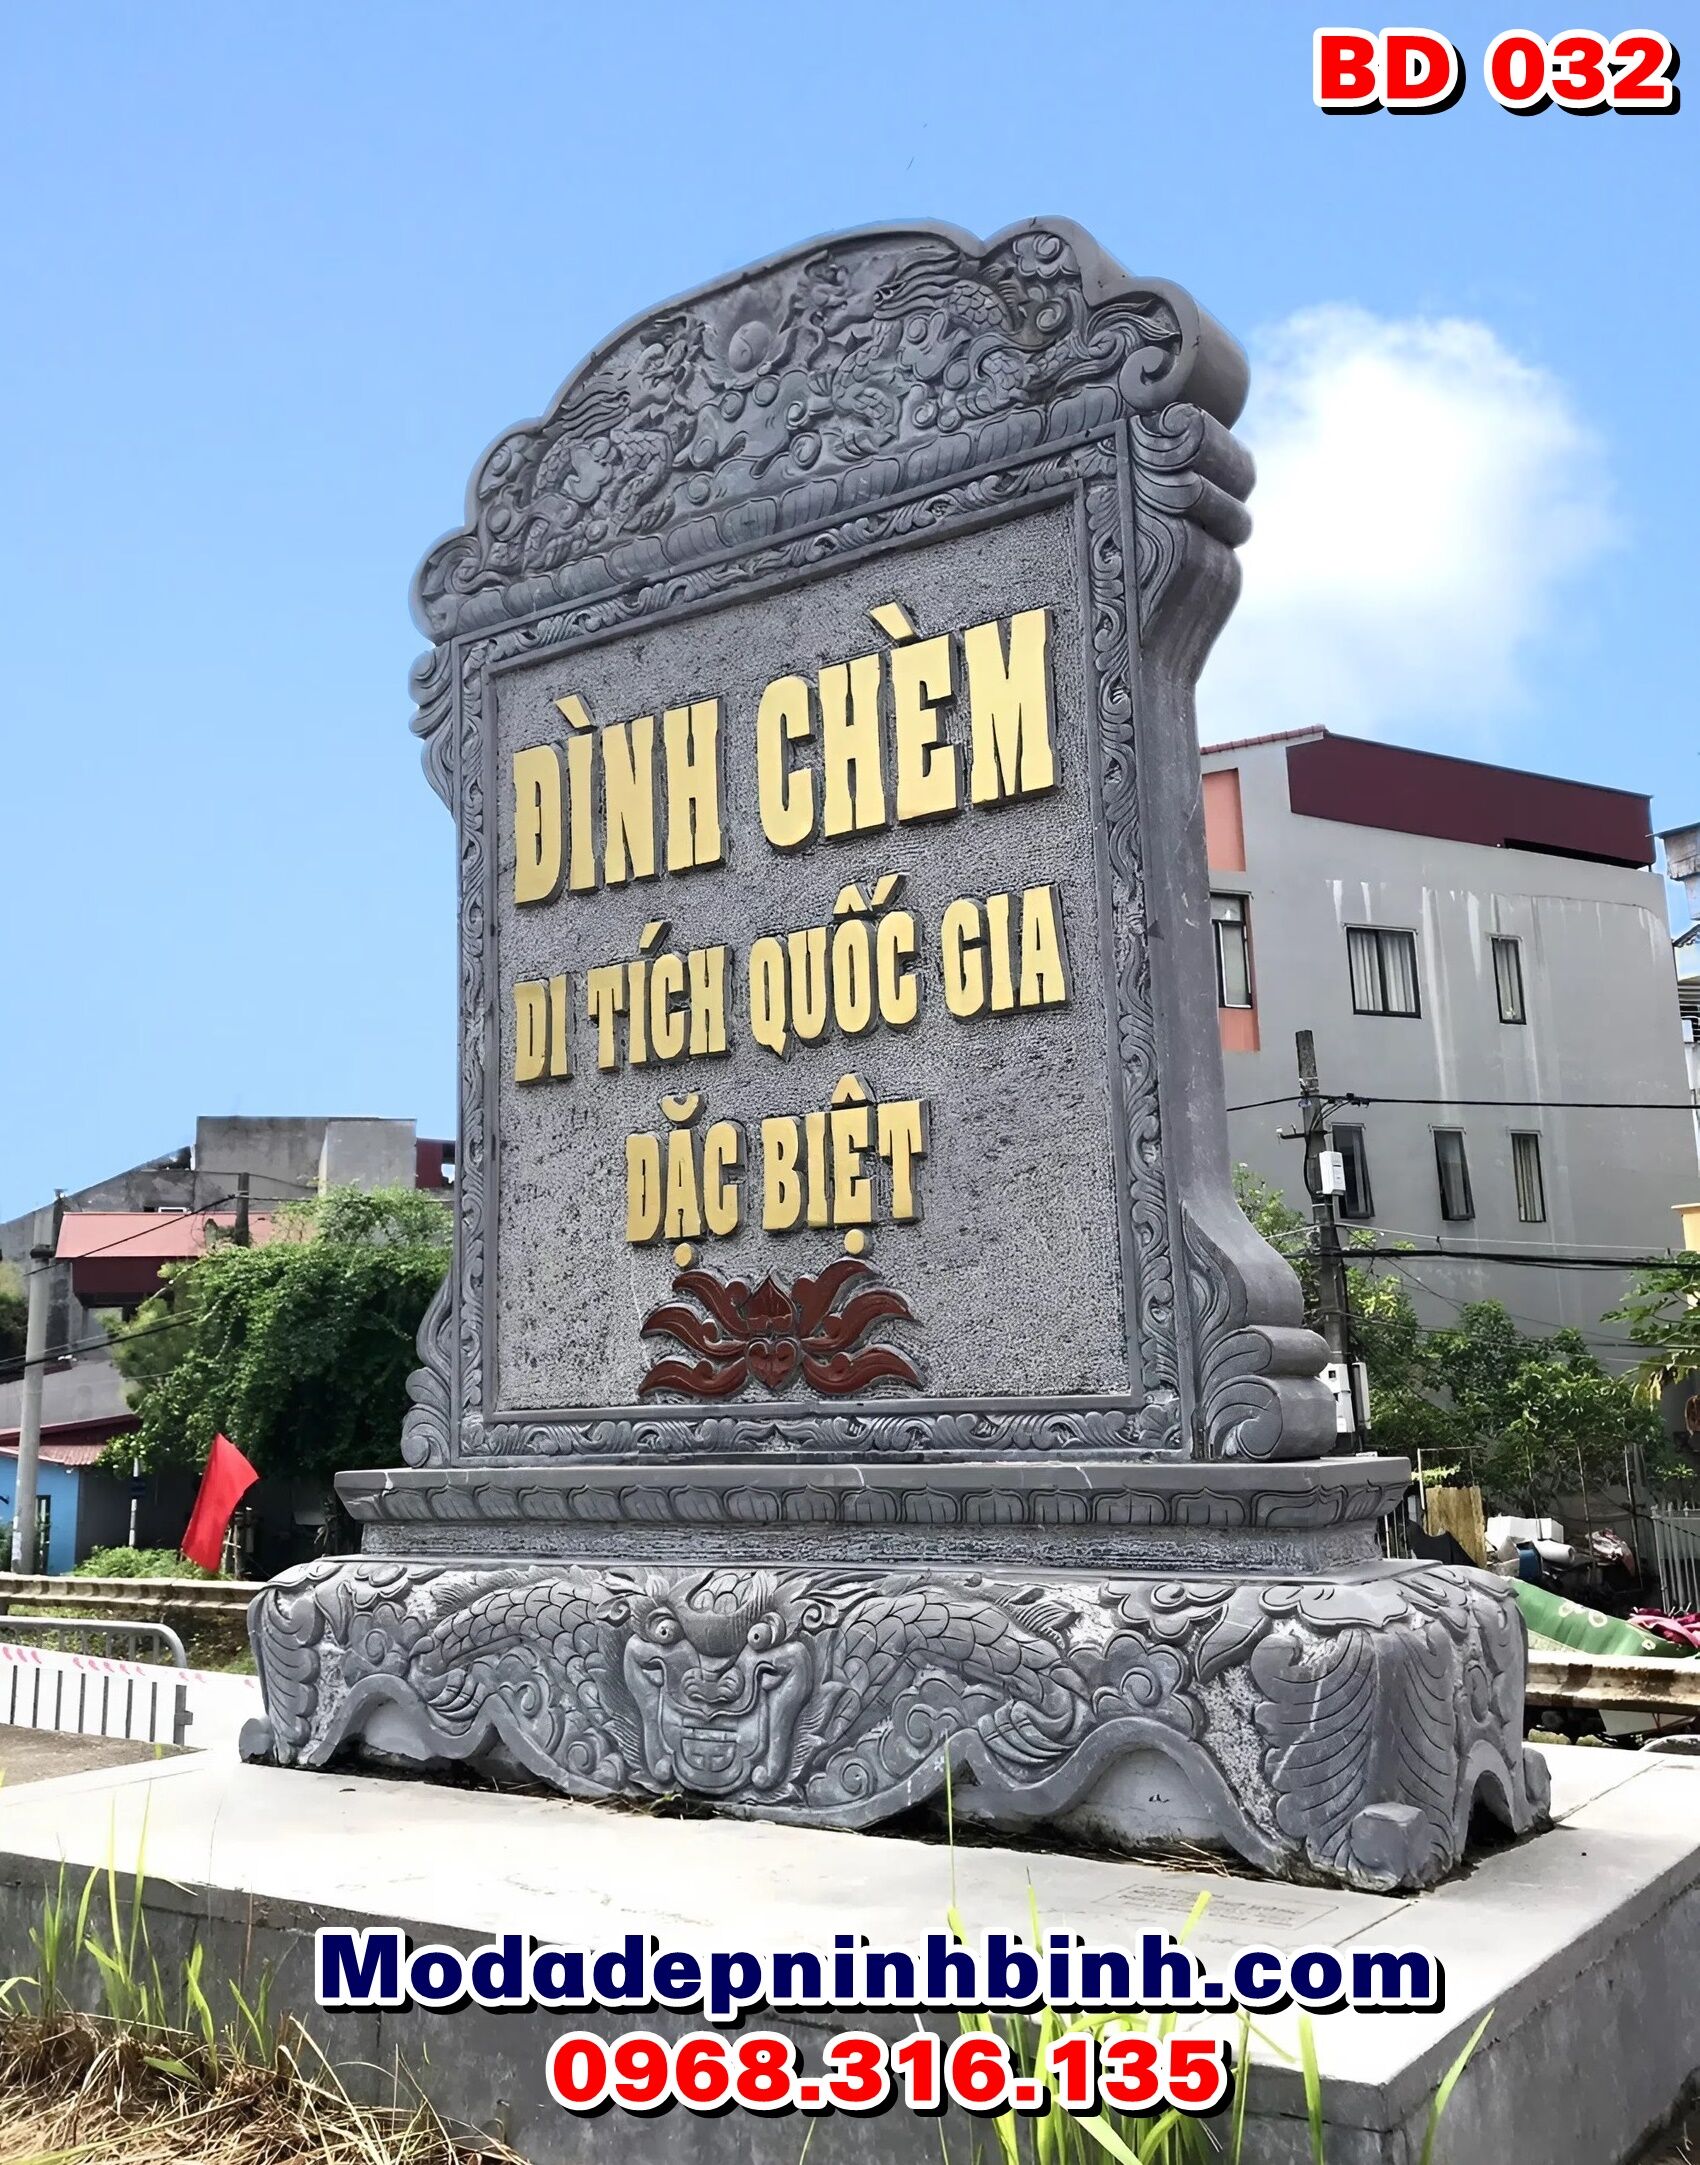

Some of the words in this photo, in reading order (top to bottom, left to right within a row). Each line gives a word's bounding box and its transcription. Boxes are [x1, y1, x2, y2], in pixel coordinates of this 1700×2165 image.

[513, 694, 724, 904] ĐÌNH
[755, 602, 1057, 848] CHÈM
[514, 973, 569, 1082] DI
[587, 921, 727, 1070] TÍCH
[749, 875, 917, 1058] QUỐC
[941, 885, 1067, 1017] GIA
[625, 1092, 739, 1268] ĐẶC
[761, 1073, 923, 1256] BIỆT
